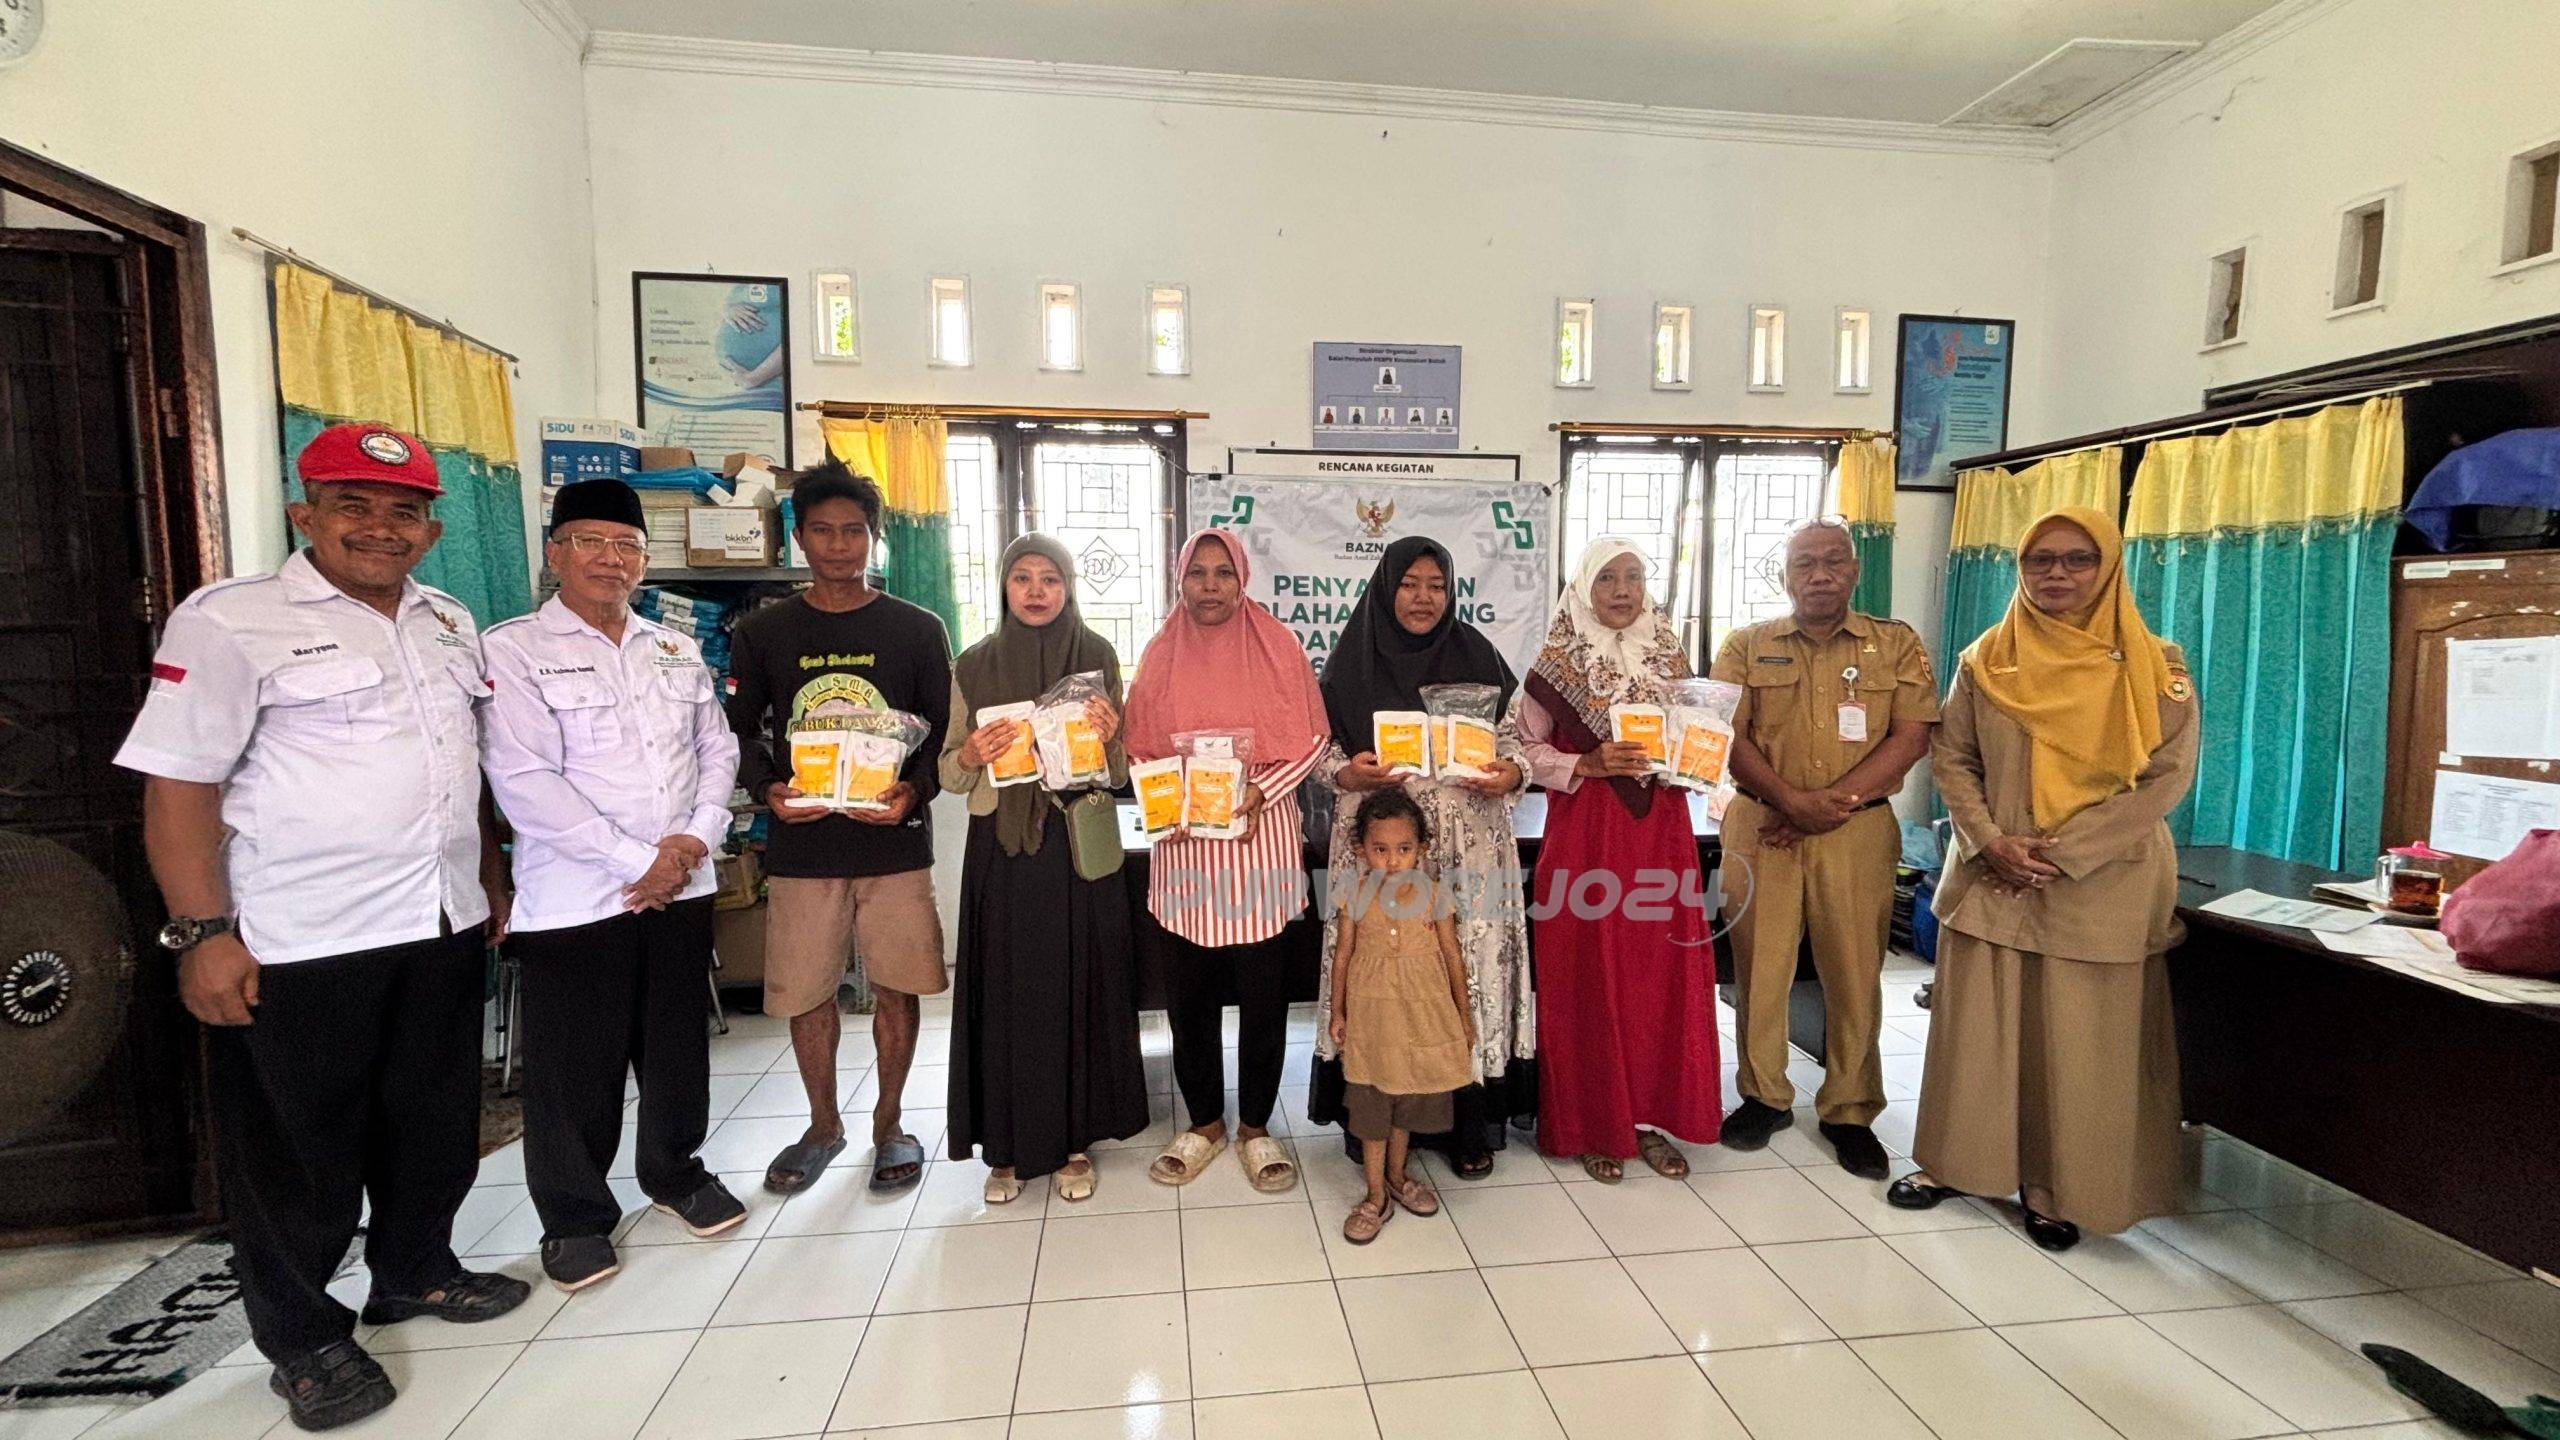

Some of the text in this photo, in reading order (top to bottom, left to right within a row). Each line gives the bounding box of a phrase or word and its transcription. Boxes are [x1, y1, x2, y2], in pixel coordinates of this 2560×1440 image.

[1318, 462, 1434, 473] RENCANA KEGIATAN
[1345, 542, 1388, 554] BAZN
[292, 643, 340, 656] Maryono
